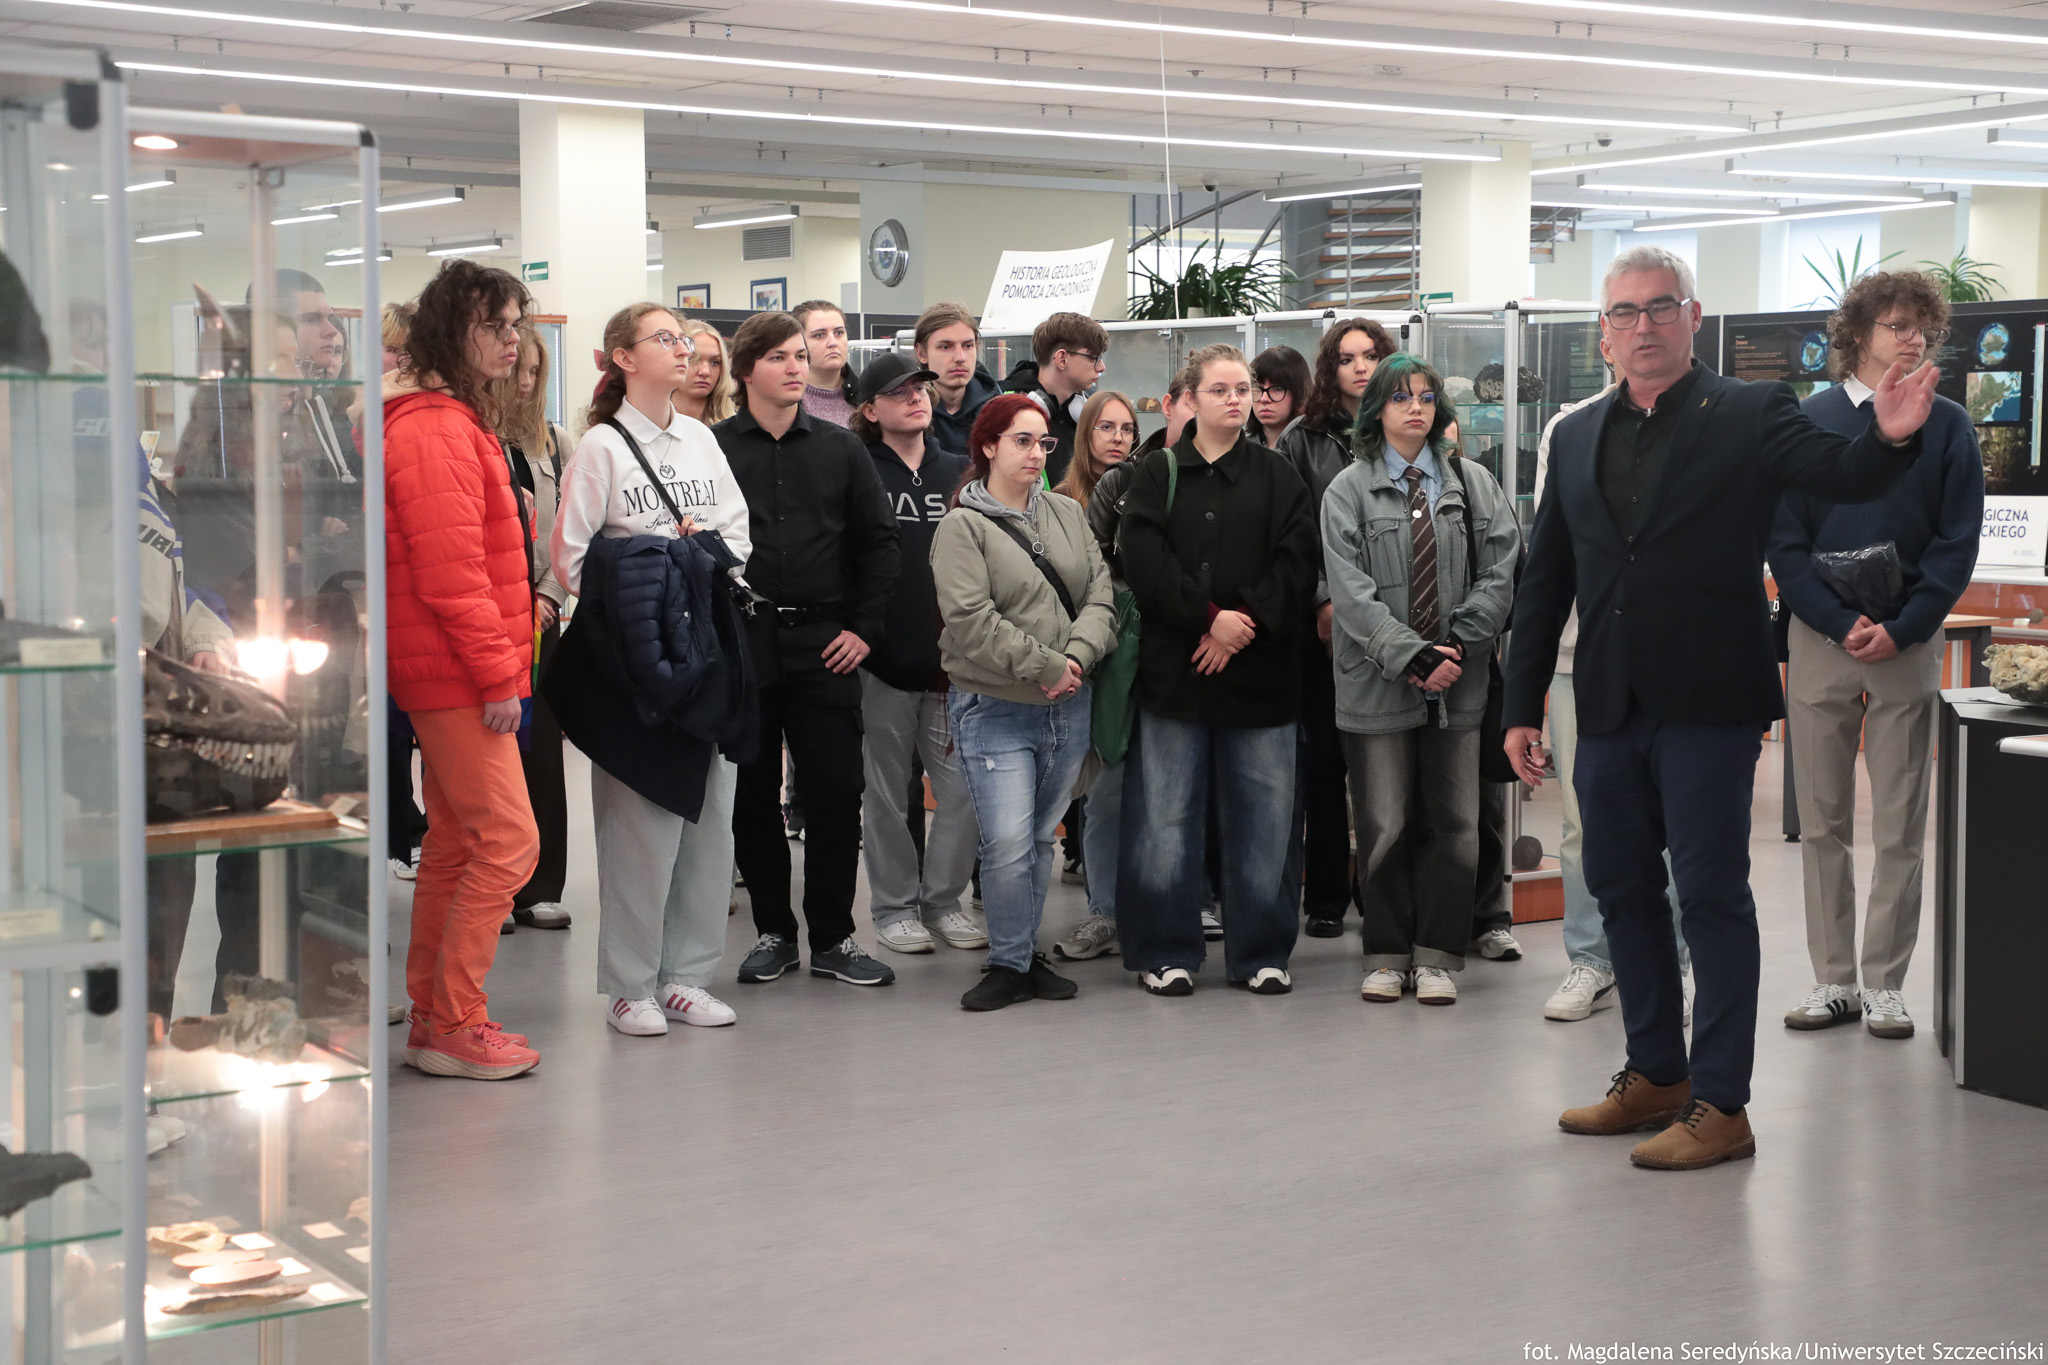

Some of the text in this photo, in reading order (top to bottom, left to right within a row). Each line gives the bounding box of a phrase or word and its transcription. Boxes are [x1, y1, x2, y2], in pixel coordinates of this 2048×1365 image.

[1010, 259, 1098, 280] HISTORIA GEOLOGICZNA
[1002, 277, 1094, 299] POMORZA ZACHODNIEGO
[622, 480, 718, 517] MOTREAL
[886, 492, 947, 522] AS
[1984, 508, 2029, 522] GICZNA
[1980, 524, 2027, 538] CKIEGO
